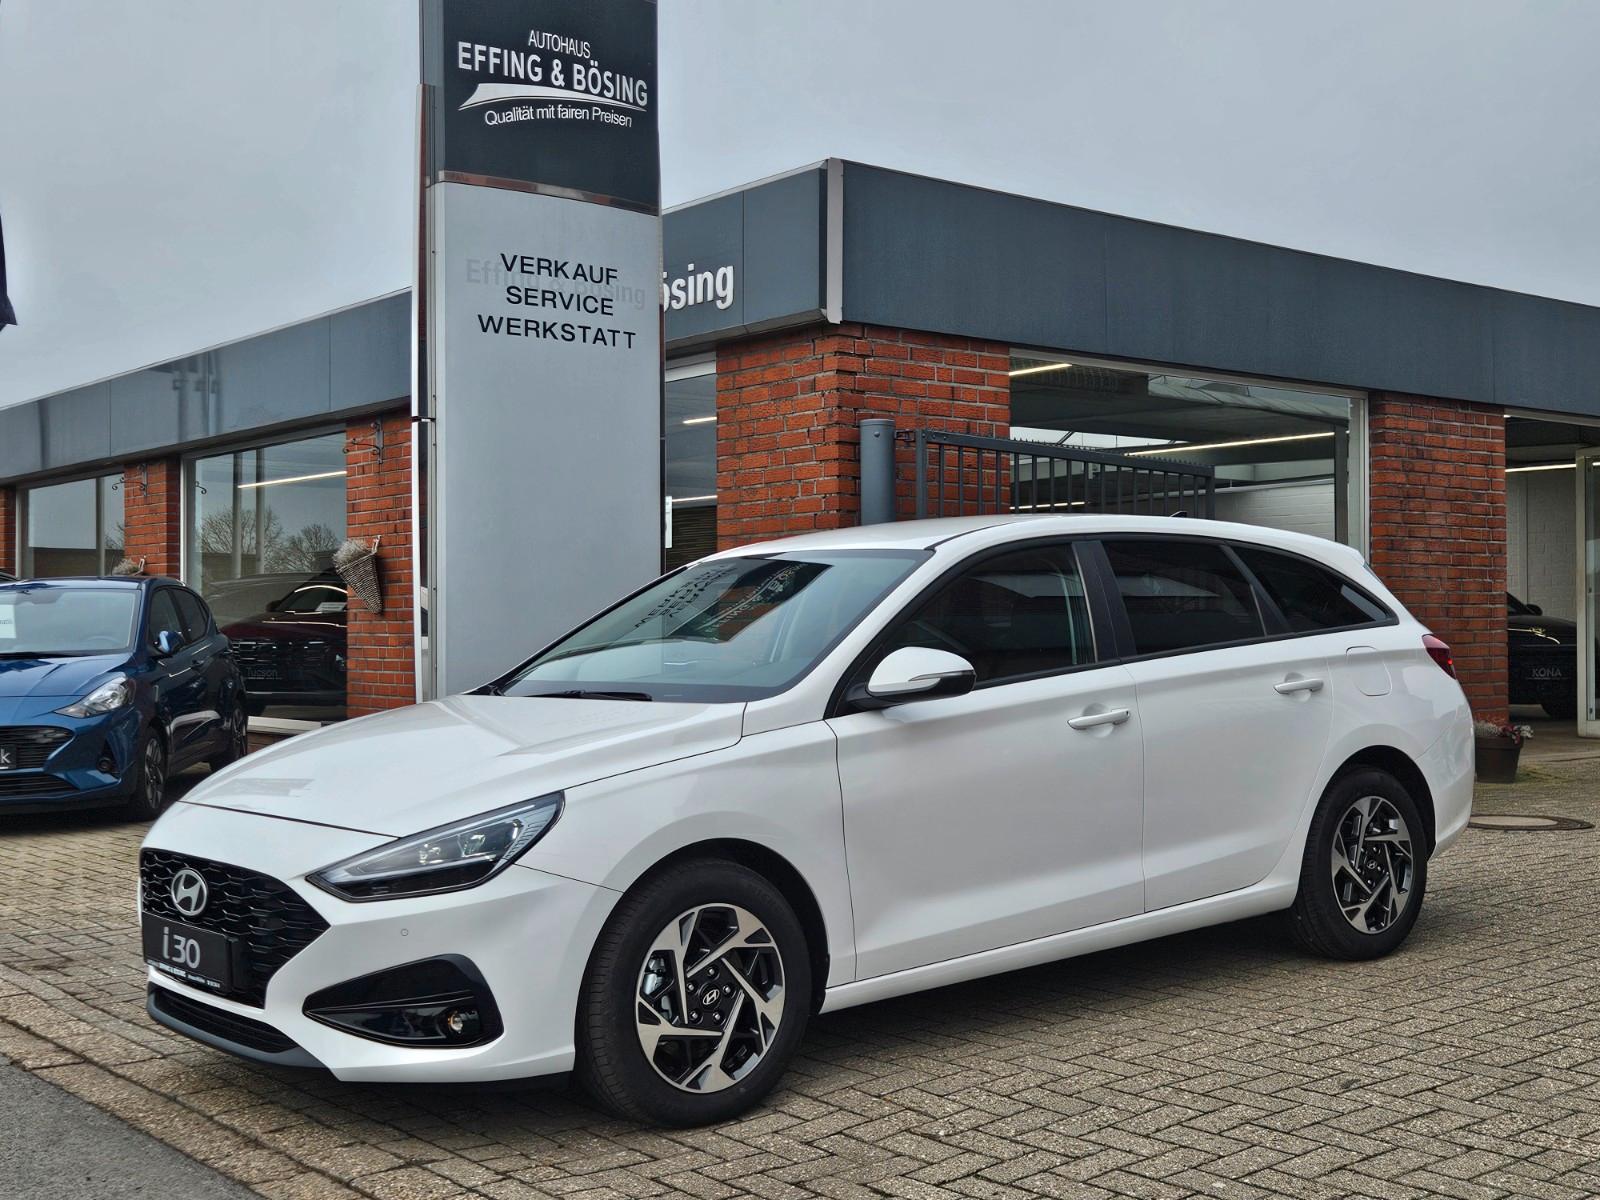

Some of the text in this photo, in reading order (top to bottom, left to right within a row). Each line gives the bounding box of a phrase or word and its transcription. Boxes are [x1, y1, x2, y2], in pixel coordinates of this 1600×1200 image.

[527, 29, 591, 59] AUTOHAUS
[457, 41, 648, 107] EFFING & BÖSING
[484, 104, 633, 128] Qualität mit fairen Preisen
[500, 253, 618, 286] VERKAUF
[506, 285, 614, 316] SERVICE
[477, 314, 636, 349] WERKSTATT
[1532, 667, 1562, 677] KONA
